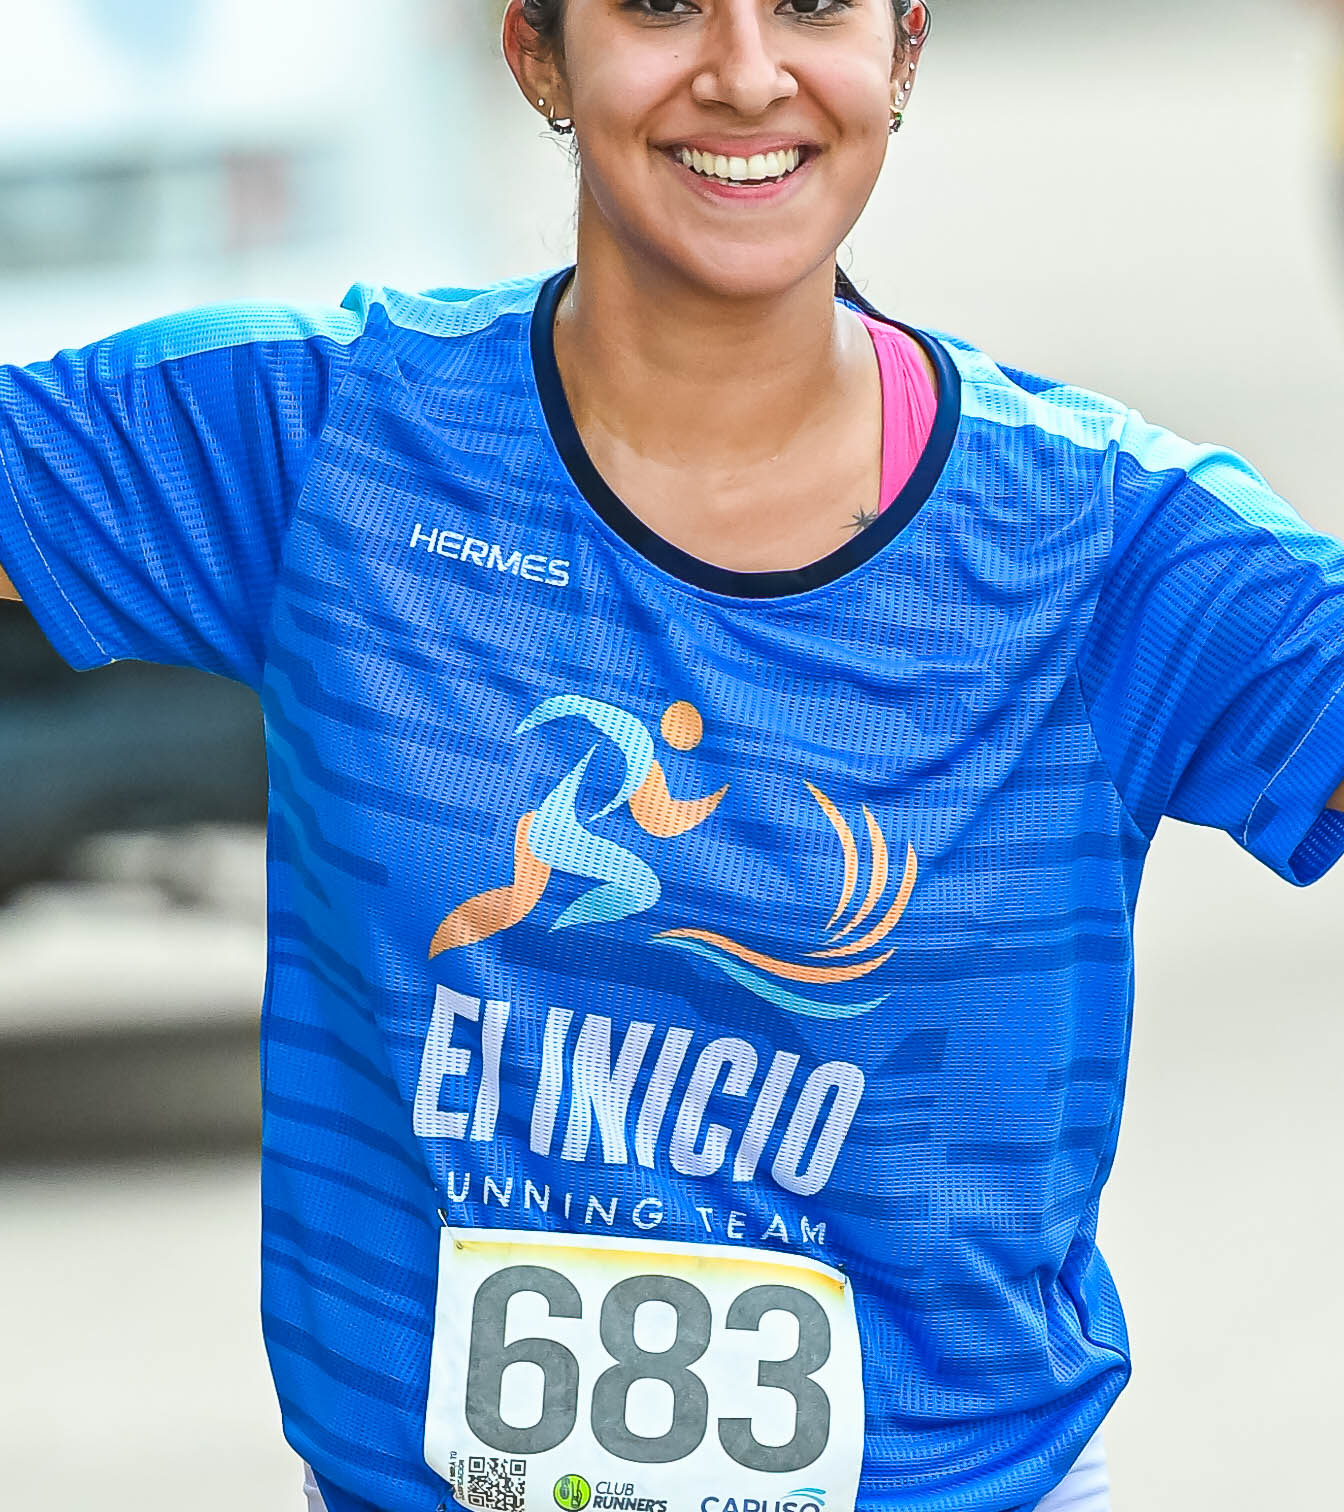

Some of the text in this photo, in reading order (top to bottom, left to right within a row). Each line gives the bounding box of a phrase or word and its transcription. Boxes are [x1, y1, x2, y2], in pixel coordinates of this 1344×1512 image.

[409, 523, 570, 587] HERMES
[529, 1006, 866, 1197] INICIO
[438, 1170, 827, 1247] UNNING TEAM
[464, 1264, 832, 1474] 683
[595, 1481, 634, 1496] CLUB
